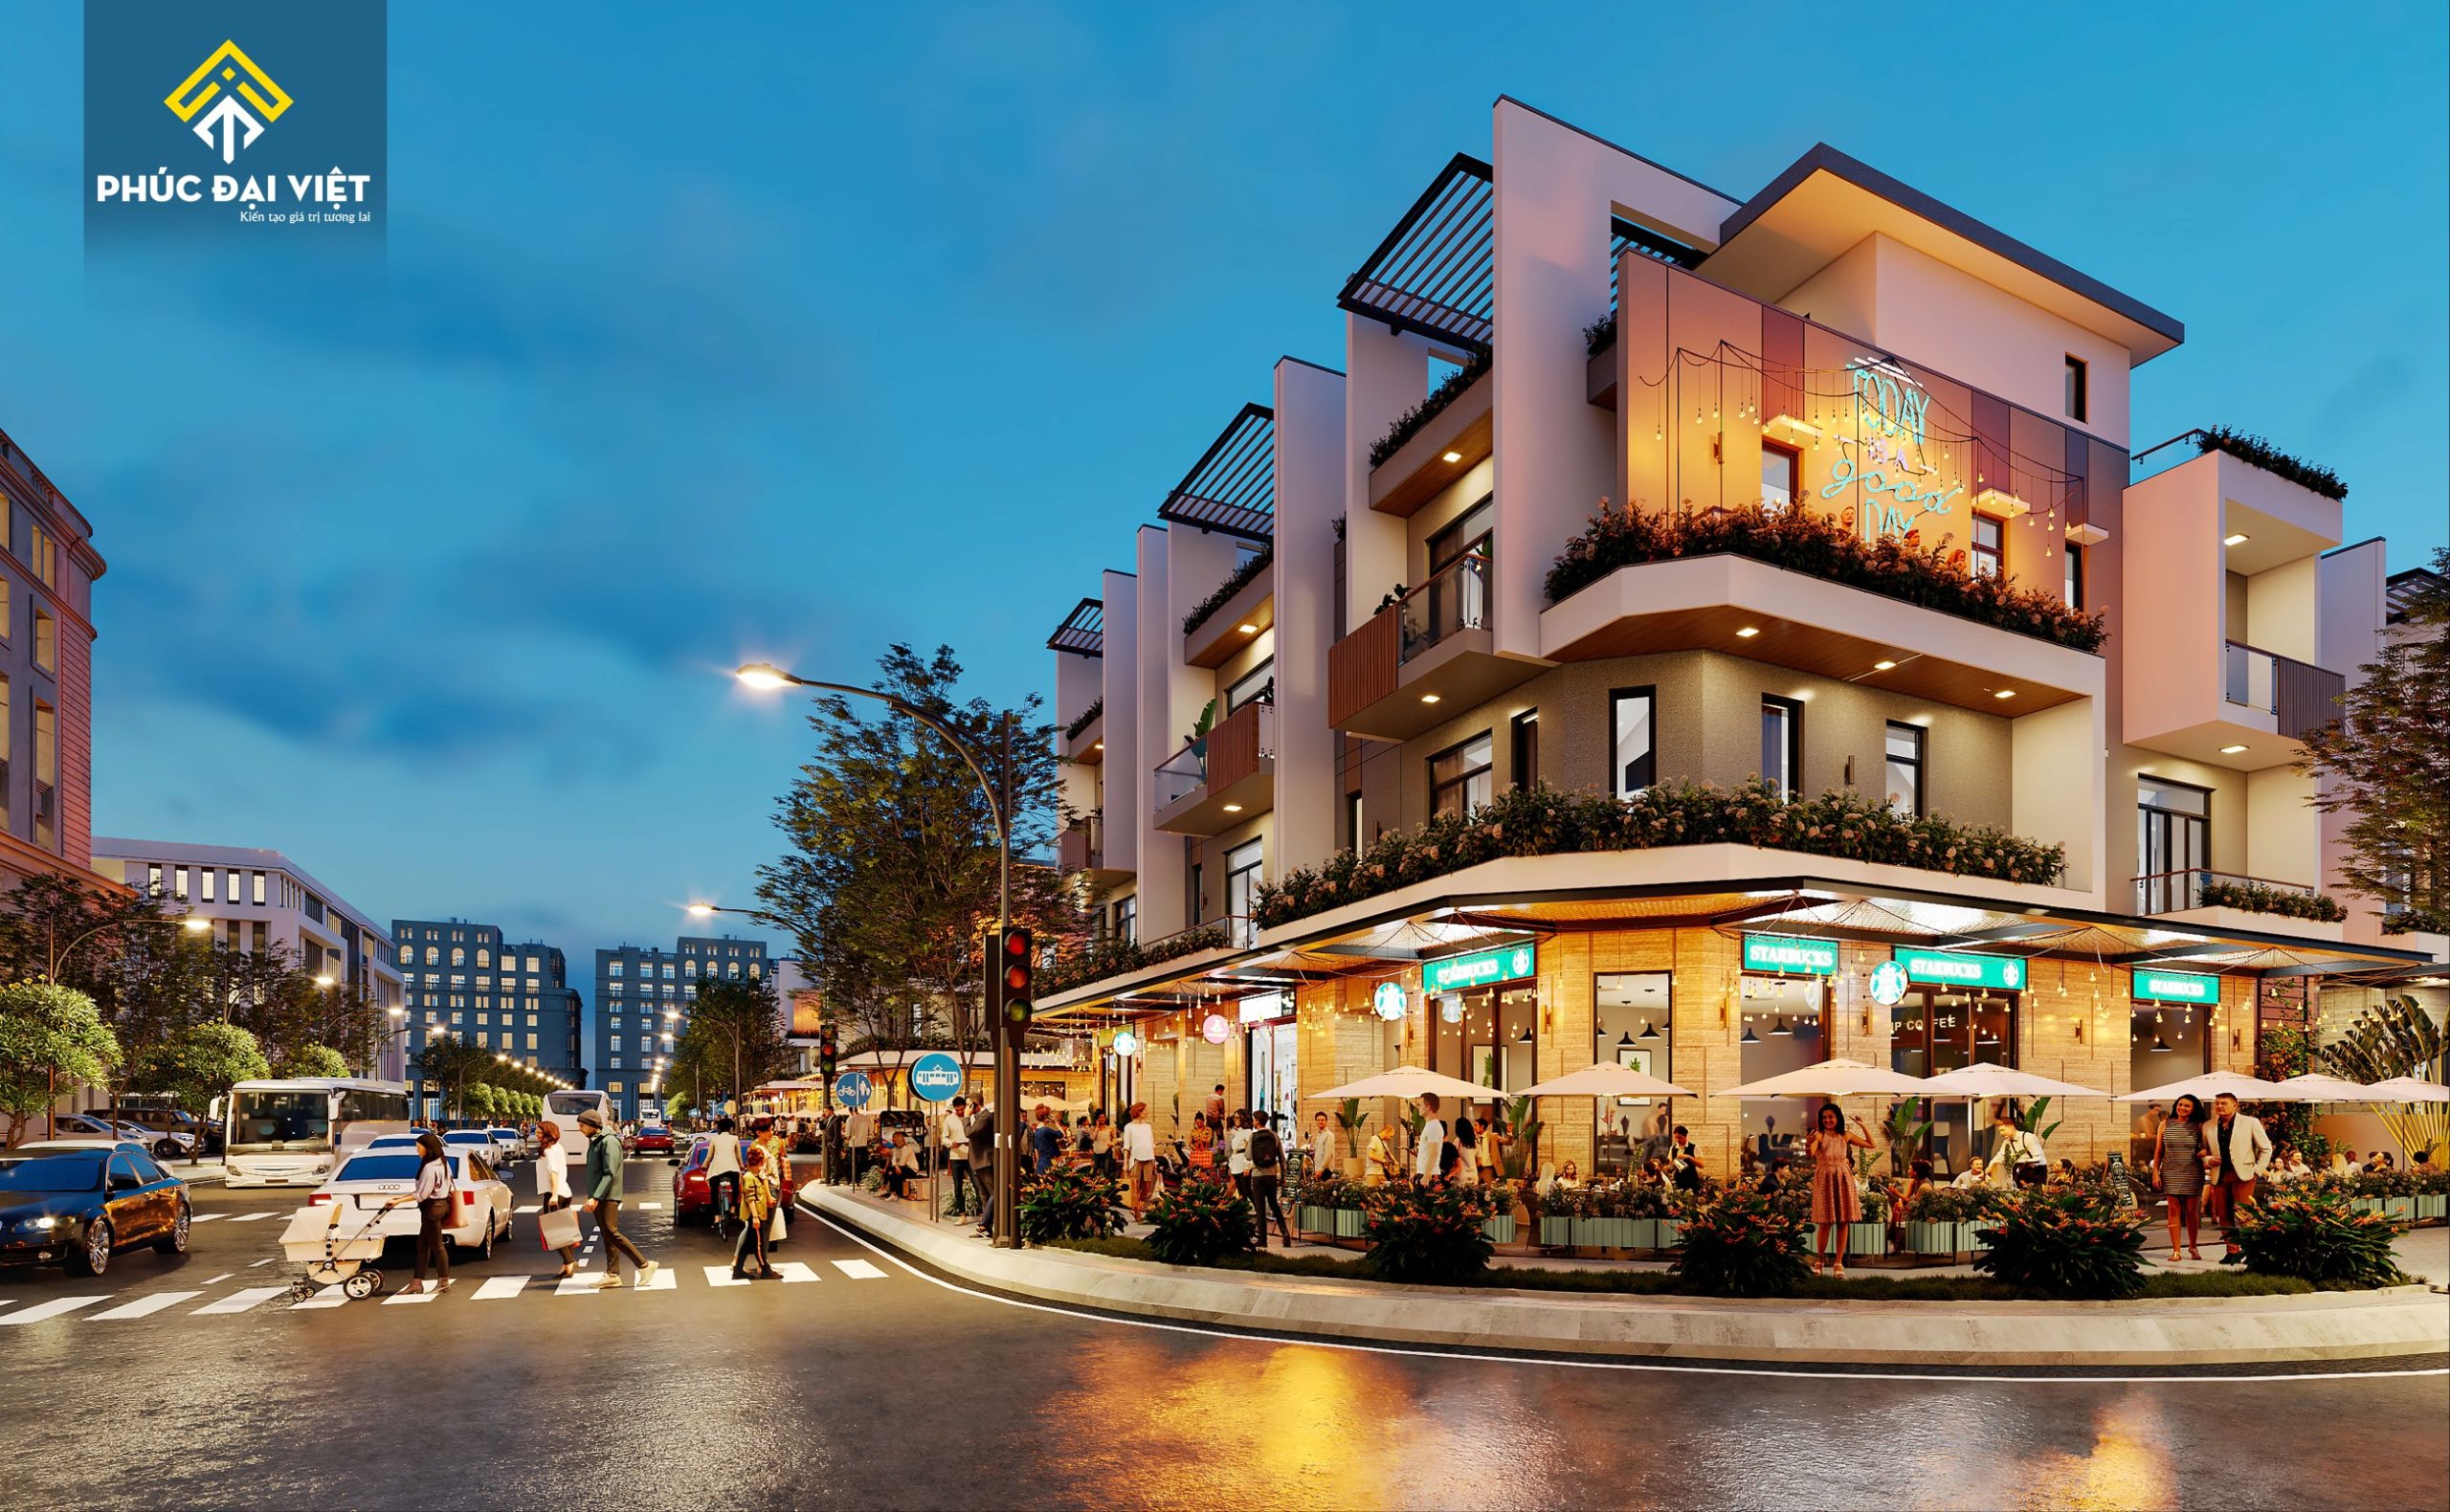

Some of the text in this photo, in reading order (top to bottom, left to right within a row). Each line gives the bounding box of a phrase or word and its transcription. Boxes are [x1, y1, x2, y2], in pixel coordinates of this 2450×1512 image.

[1846, 364, 1929, 444] TODAY
[1749, 944, 1833, 967] STARBUCKS
[1909, 958, 1982, 979] STARBUCKS
[1906, 1016, 1956, 1032] COFEE
